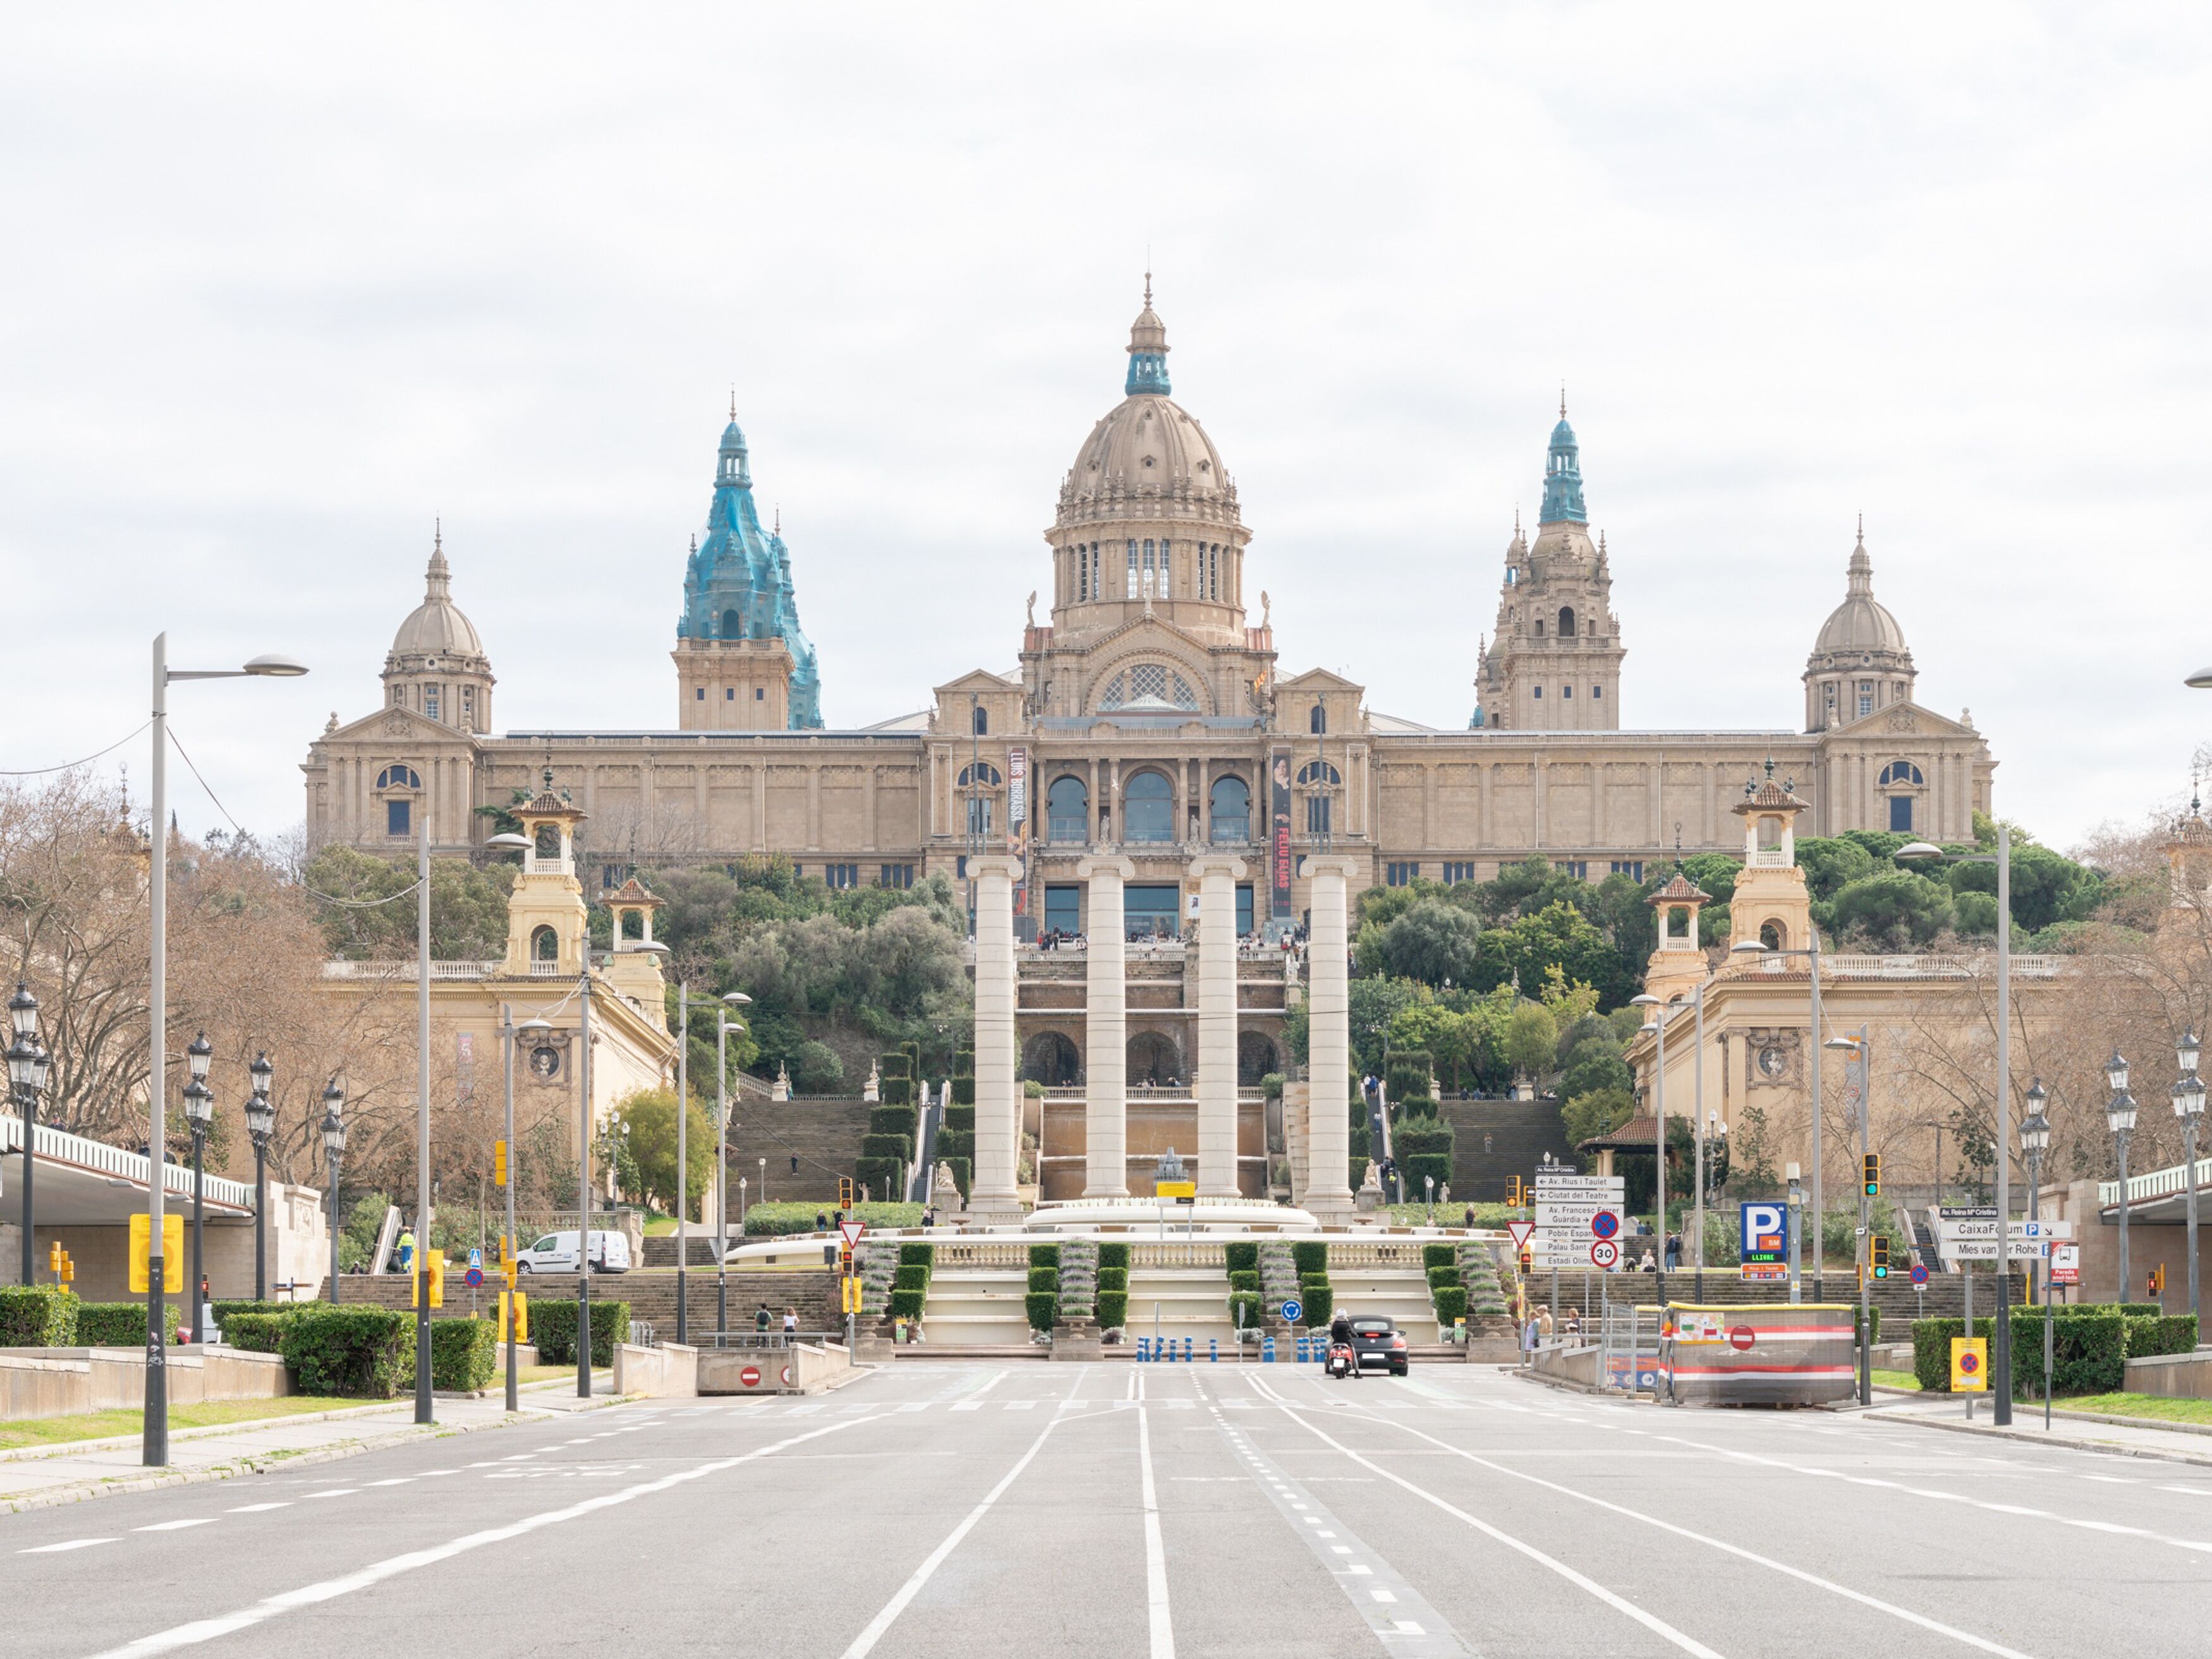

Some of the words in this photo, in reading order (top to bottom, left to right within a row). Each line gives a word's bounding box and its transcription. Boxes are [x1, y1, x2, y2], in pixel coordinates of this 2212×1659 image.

[1011, 753, 1026, 775] LLUÍS
[1279, 828, 1289, 856] FELIU
[1279, 860, 1289, 888] ELIAS
[1747, 1206, 1781, 1250] P
[1596, 1249, 1612, 1258] 30
[1959, 1244, 1978, 1254] Mies
[2015, 1244, 2038, 1254] Rohe
